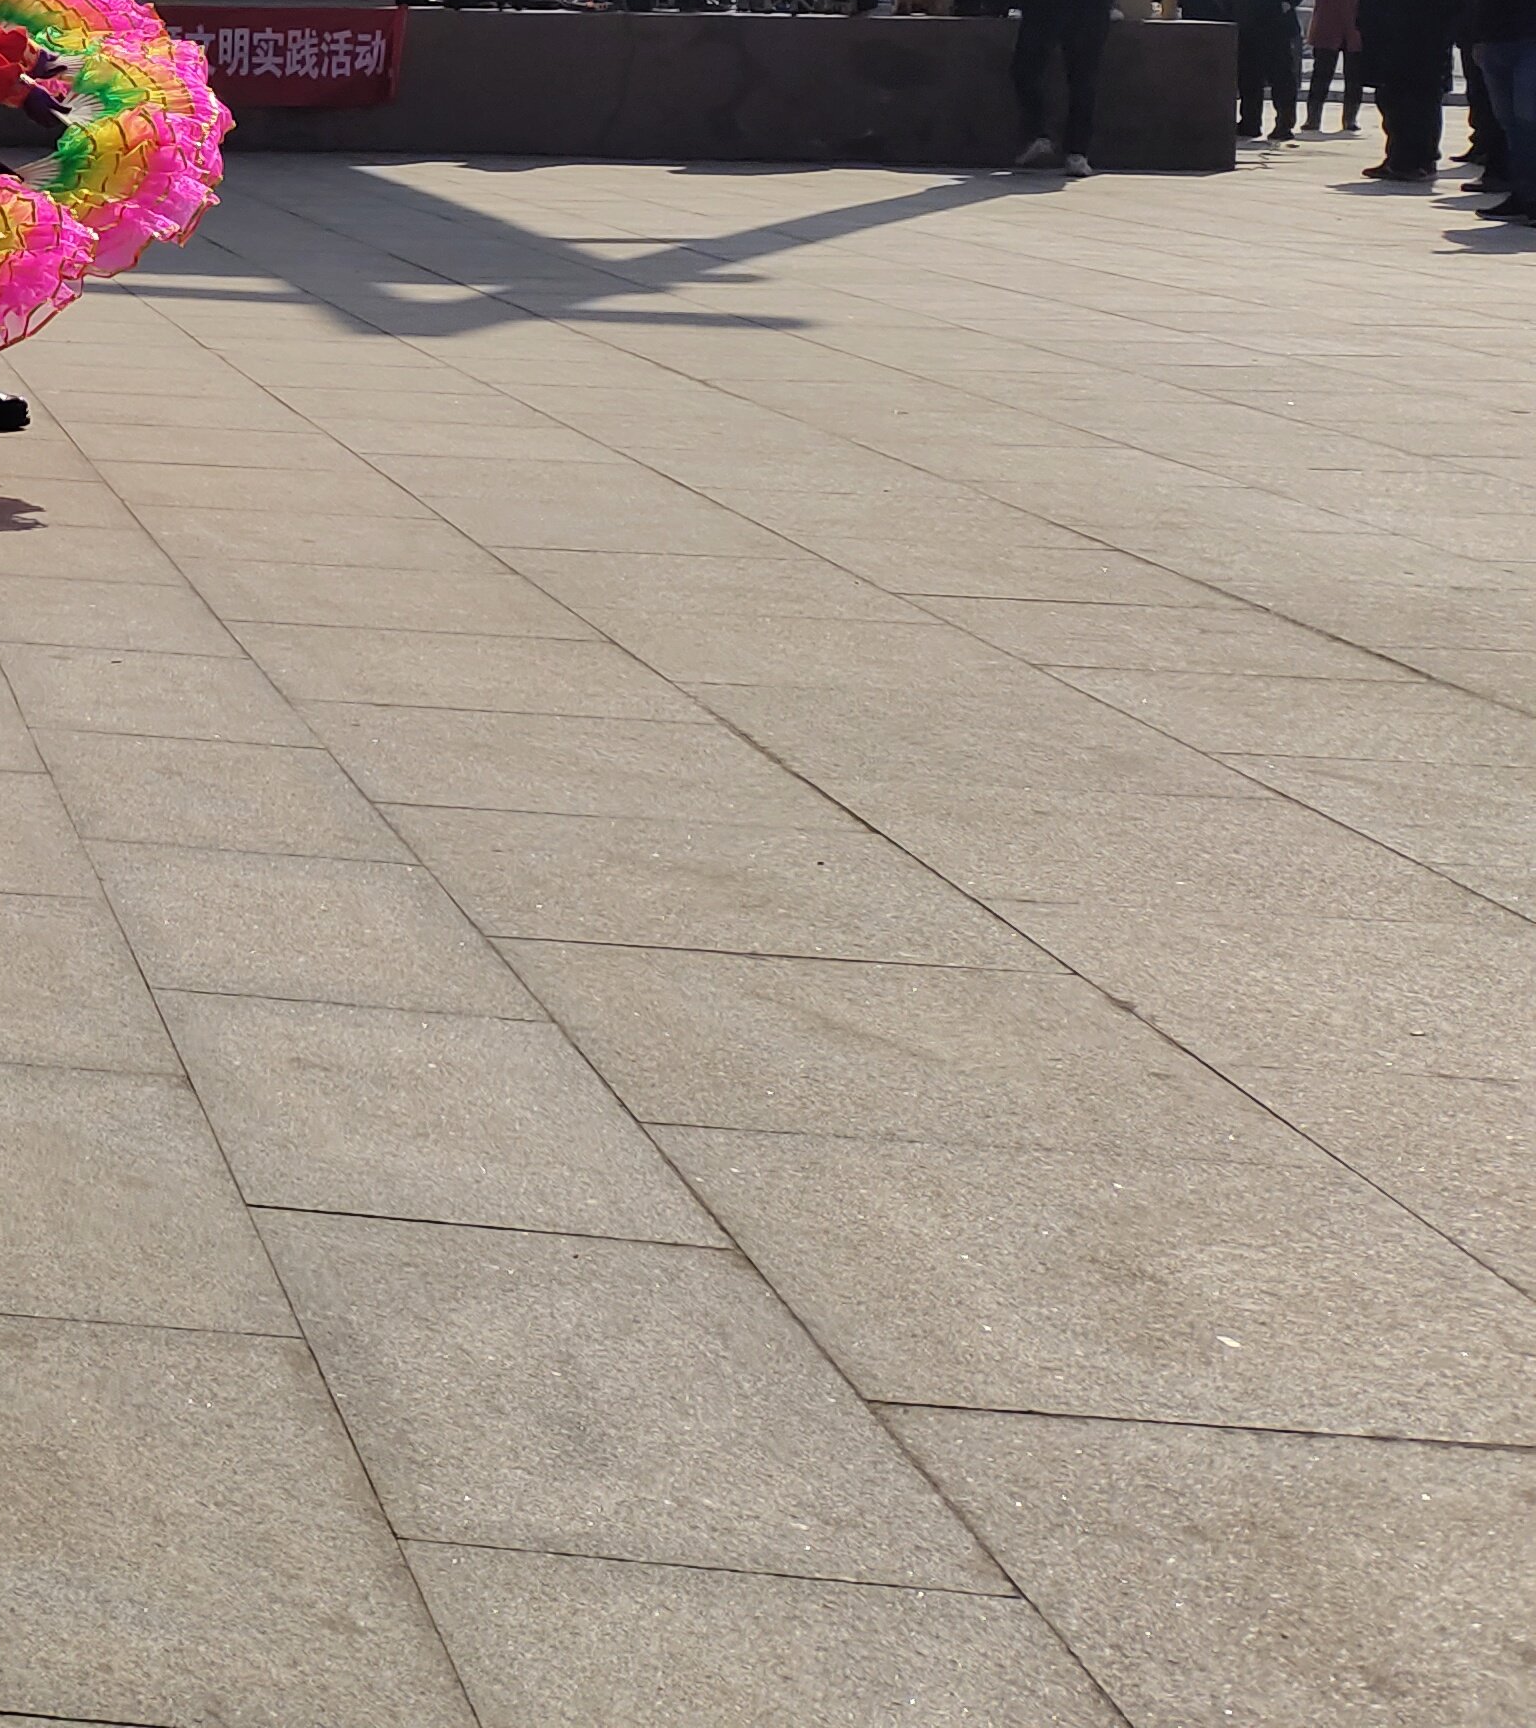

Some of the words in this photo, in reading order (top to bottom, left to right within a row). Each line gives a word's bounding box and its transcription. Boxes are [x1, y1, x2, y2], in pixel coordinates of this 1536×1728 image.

[167, 24, 387, 79] 明实践活动
